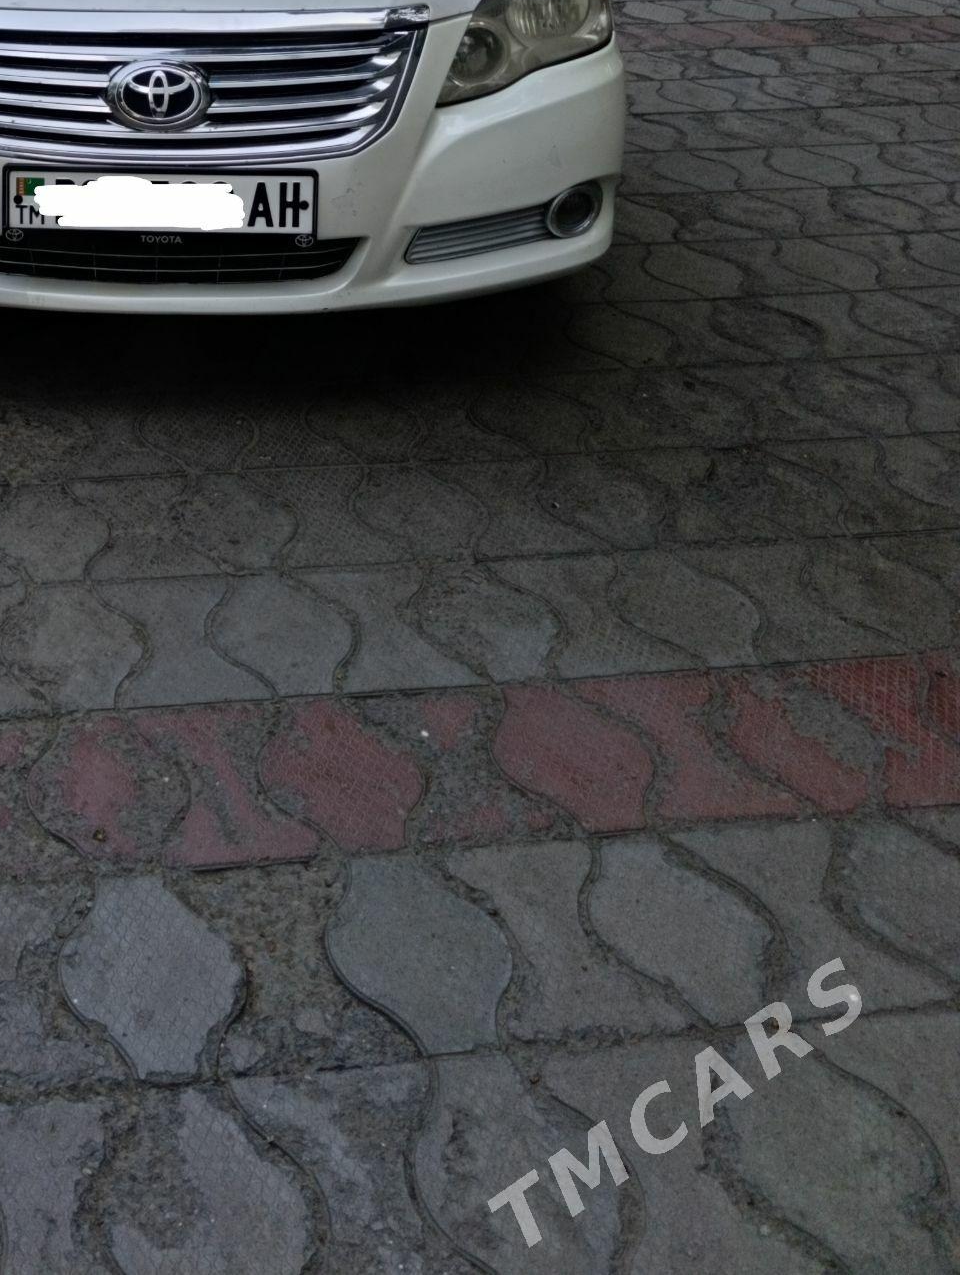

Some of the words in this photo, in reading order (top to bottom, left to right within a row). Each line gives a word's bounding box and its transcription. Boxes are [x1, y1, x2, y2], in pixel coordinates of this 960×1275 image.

[16, 205, 45, 225] TM
[247, 182, 301, 228] AH
[141, 235, 183, 244] TOYOTA
